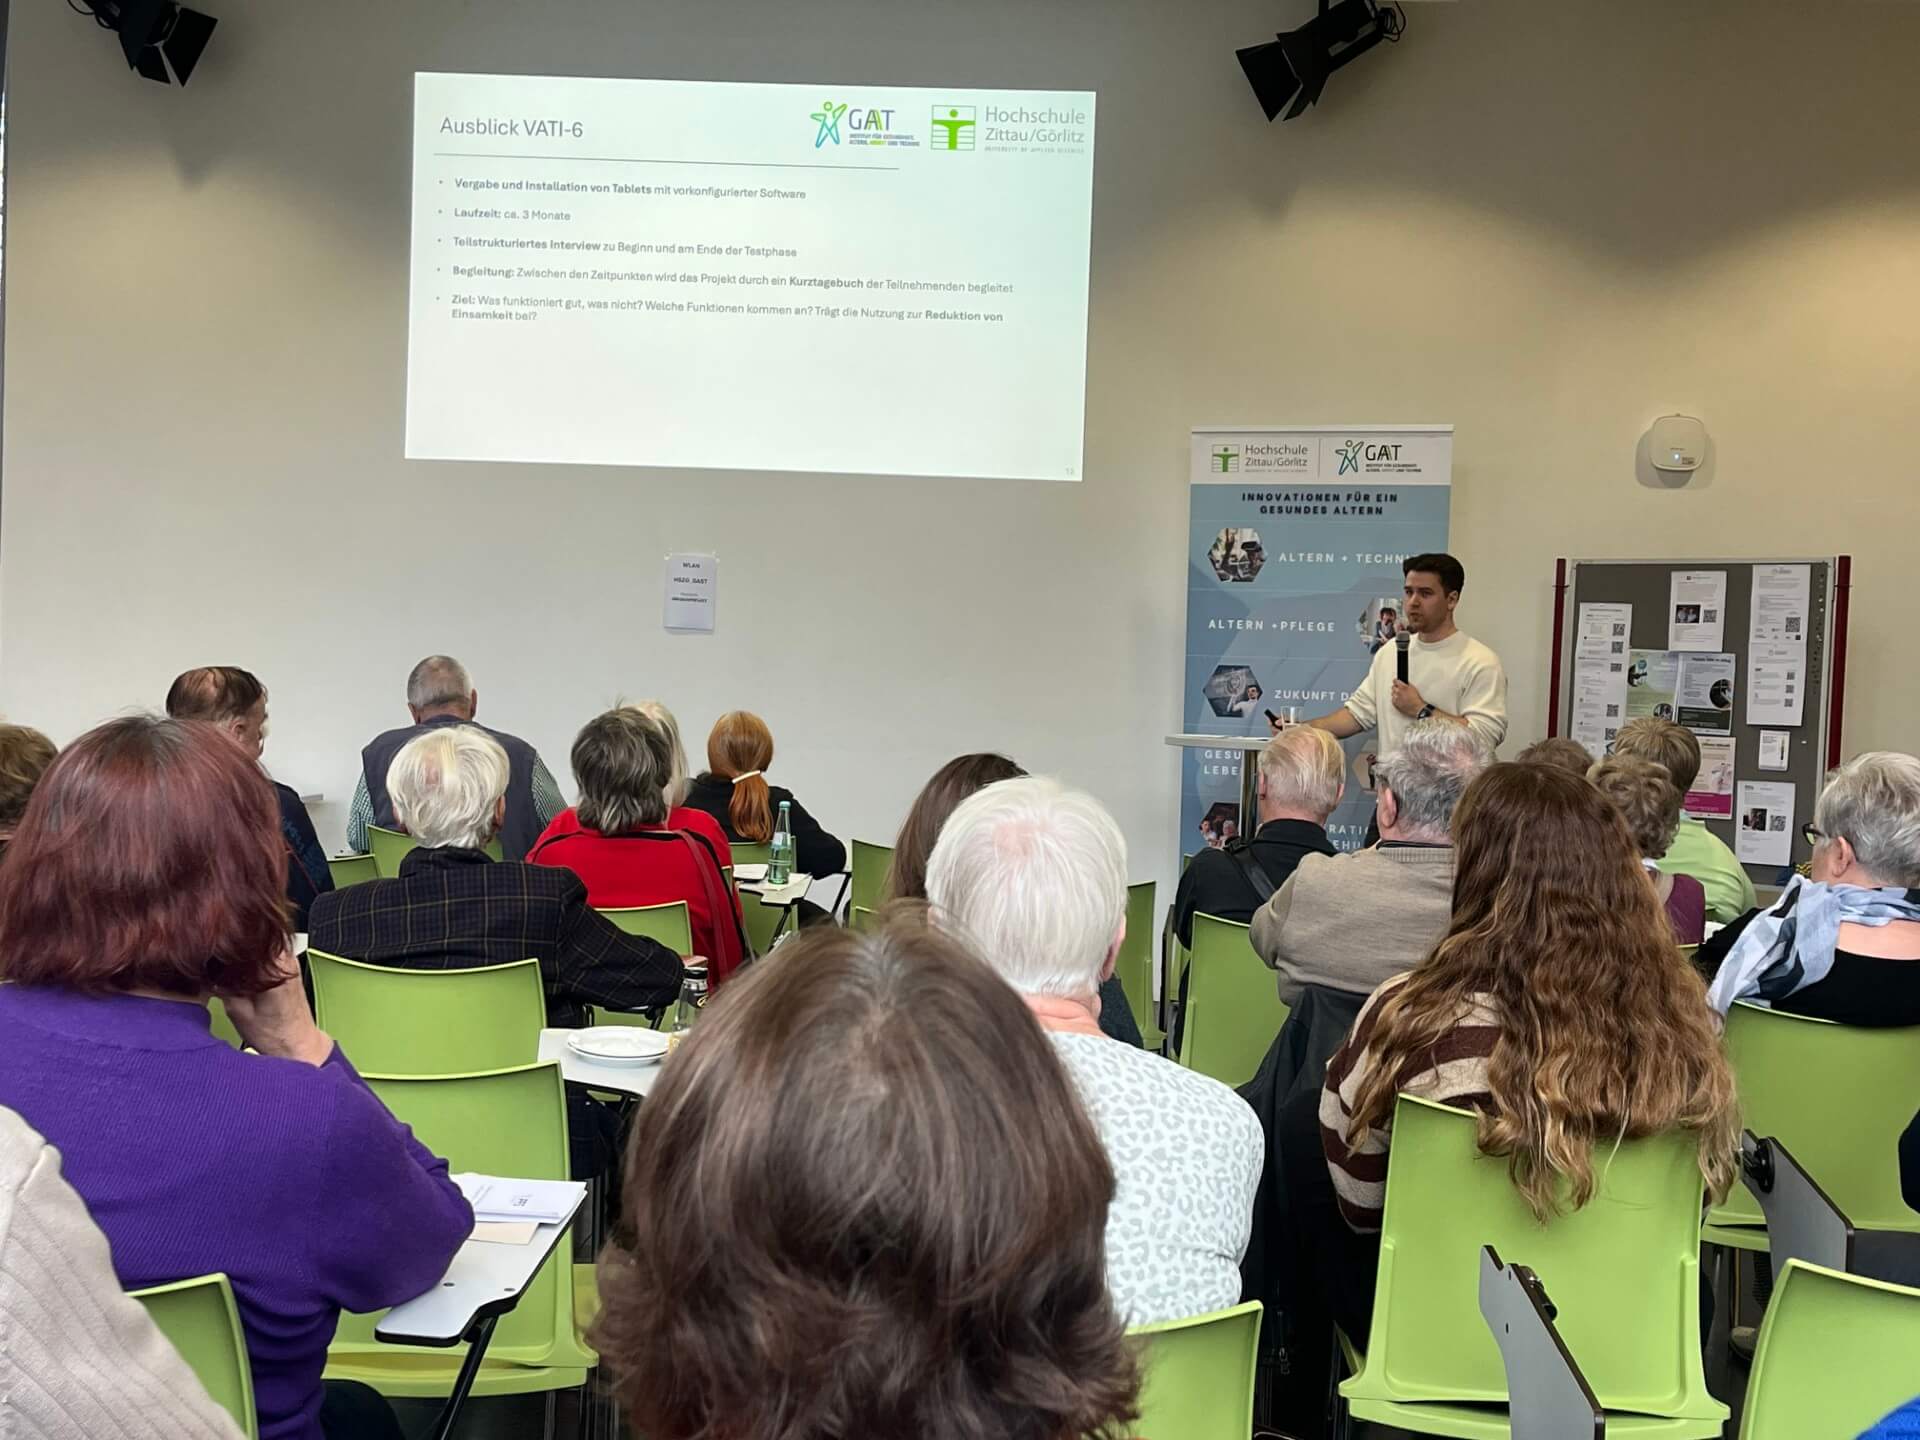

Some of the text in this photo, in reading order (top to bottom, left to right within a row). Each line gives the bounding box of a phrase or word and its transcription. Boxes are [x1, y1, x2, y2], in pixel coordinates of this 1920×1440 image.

[985, 105, 1086, 124] Hochschule
[439, 117, 584, 138] Ausblick VATI-6
[985, 127, 1085, 143] Zittau/Görlitz
[454, 178, 807, 199] Vergabe und Installation von Tablets mit vorkonfigurierter Software
[454, 207, 571, 221] Laufzeit: ca. 3 Monate
[453, 236, 798, 259] Teilstrukturiertes Interview zu Beginn und am Ende der Testphase
[452, 265, 1014, 295] Begleitung: Zwischen den Zeitpunkten wird das Projekt durch ein Kurztagebuch der Teilnehmenden begleitet
[451, 294, 476, 305] Ziel:
[477, 295, 501, 306] Was
[502, 296, 563, 308] funktioniert
[564, 299, 585, 310] gut,
[587, 300, 609, 309] was
[610, 299, 644, 310] nicht?
[644, 300, 685, 312] Welche
[686, 301, 745, 313] Funktionen
[746, 303, 792, 315] kommen
[794, 305, 814, 316] an?
[841, 306, 859, 317] die
[860, 307, 905, 321] Nutzung
[906, 311, 923, 319] zur
[925, 309, 981, 321] Reduktion
[983, 313, 1004, 322] von
[451, 308, 538, 321] Einsamkeit bei?
[1245, 444, 1308, 455] Hochschule
[1245, 457, 1308, 467] Zittau/Görlitz
[1242, 490, 1398, 503] INNOVATIONEN FÜR EIN
[1260, 505, 1384, 515] GESUNDES ALTERN
[1279, 552, 1334, 563] ALTERN
[1208, 620, 1264, 631] ALTERN
[1274, 689, 1349, 701] ZUKUNFT D
[1204, 750, 1241, 760] GESU
[1203, 764, 1239, 776] LEBE
